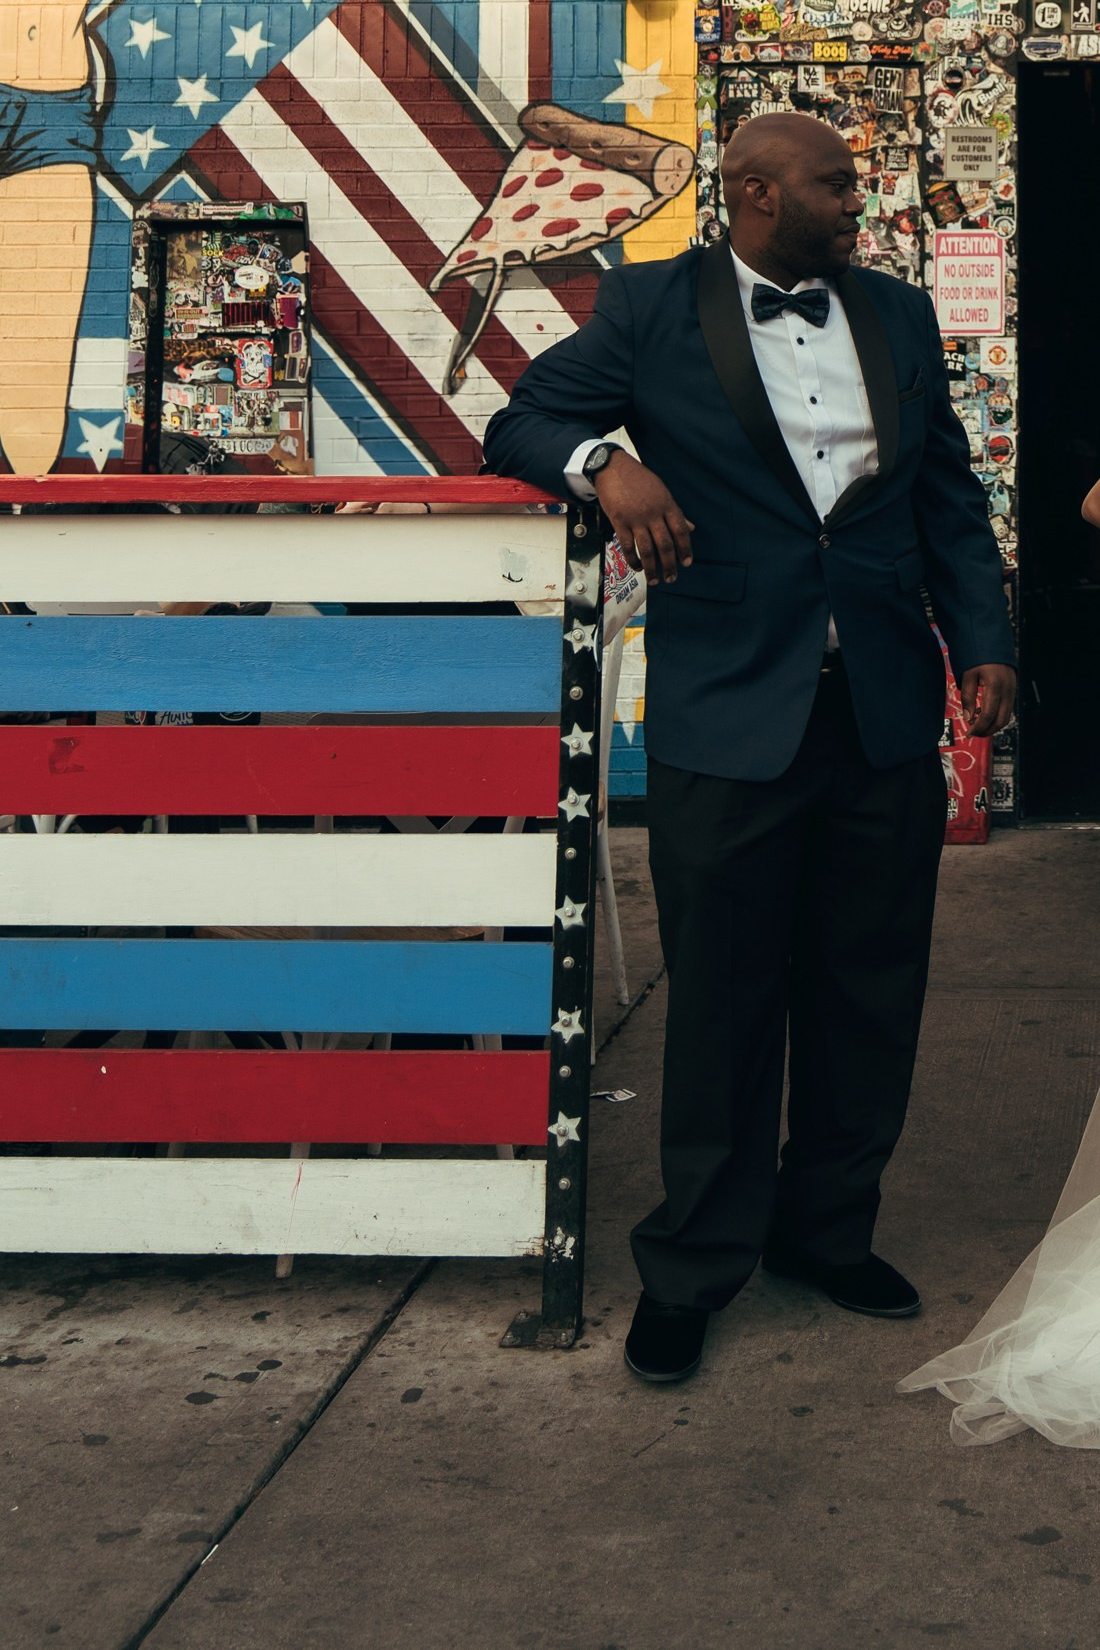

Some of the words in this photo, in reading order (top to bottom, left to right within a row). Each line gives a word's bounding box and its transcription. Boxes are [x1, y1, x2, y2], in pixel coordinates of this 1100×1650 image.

[977, 82, 1006, 106] Buell
[951, 135, 993, 143] RESTROOMS
[940, 237, 999, 254] ATTENTION
[944, 264, 956, 278] NO
[959, 264, 995, 278] OUTSIDE
[940, 287, 960, 300] FOOD
[962, 287, 973, 300] OR
[975, 287, 999, 300] DRINK
[949, 308, 989, 322] ALLOWED
